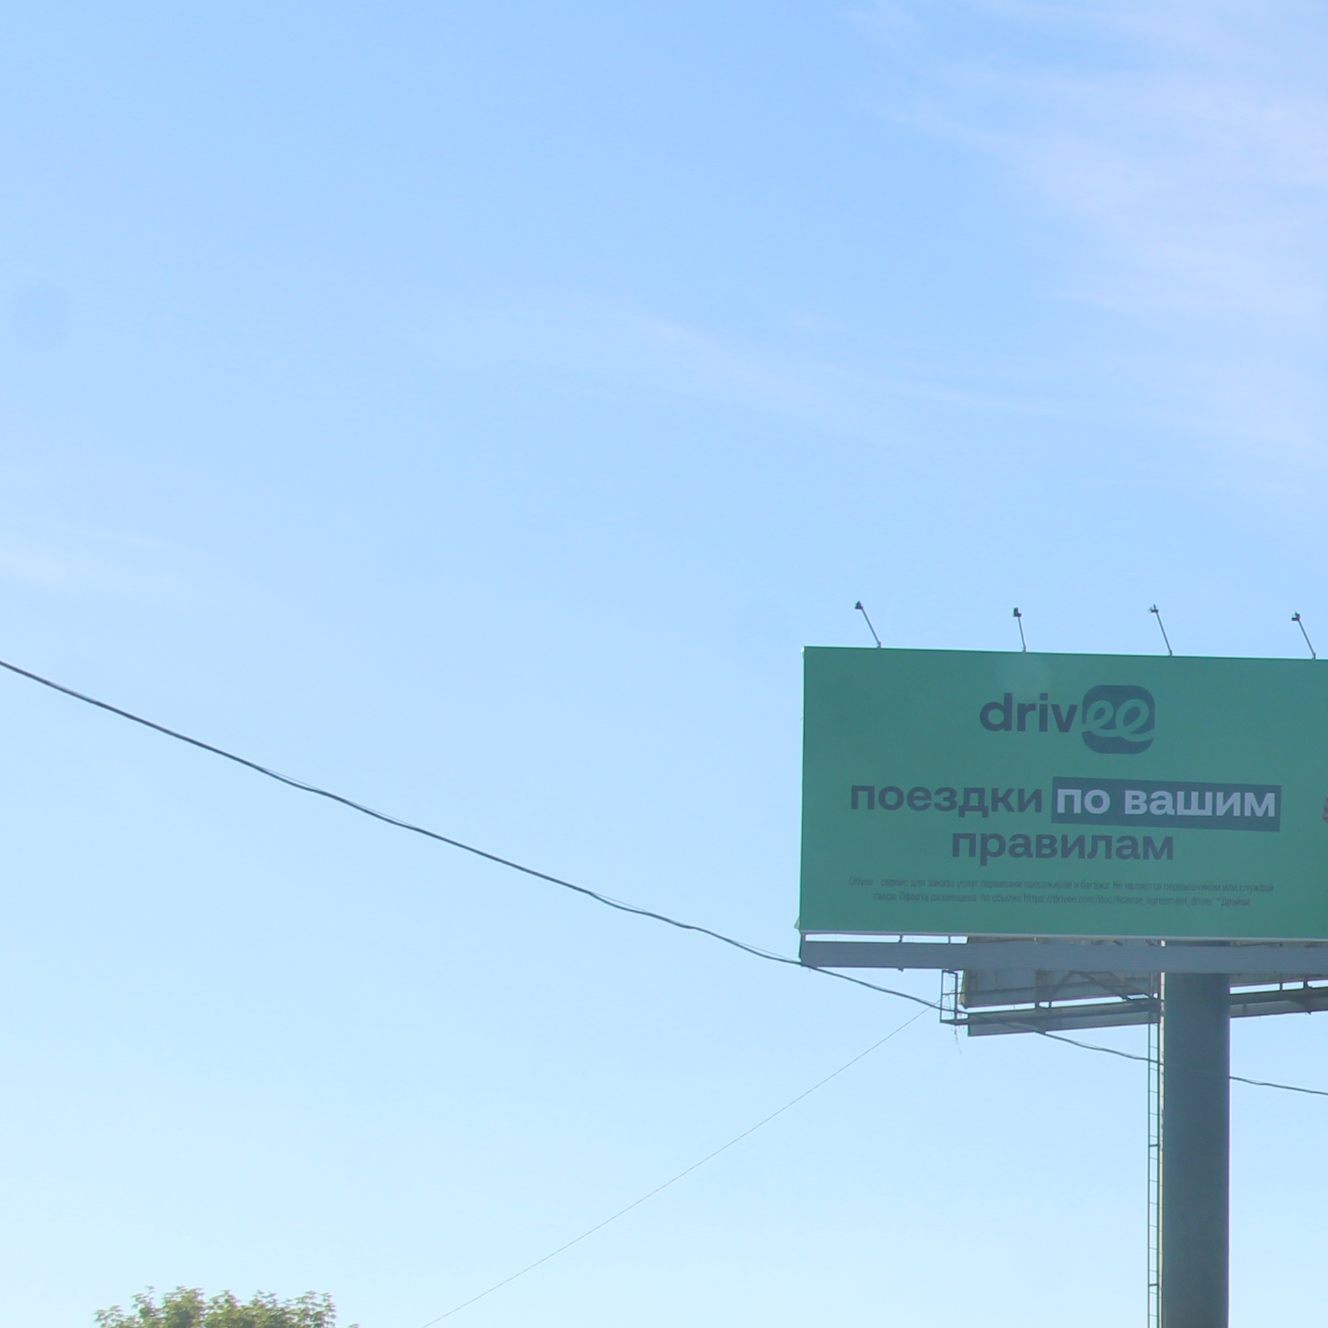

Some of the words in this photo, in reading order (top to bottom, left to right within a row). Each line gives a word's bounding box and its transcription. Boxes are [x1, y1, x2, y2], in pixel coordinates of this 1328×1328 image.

[979, 691, 1155, 744] drivee
[851, 785, 1043, 818] поездки
[1056, 788, 1110, 815] по
[1125, 789, 1276, 818] вашим
[952, 832, 1174, 866] правилам
